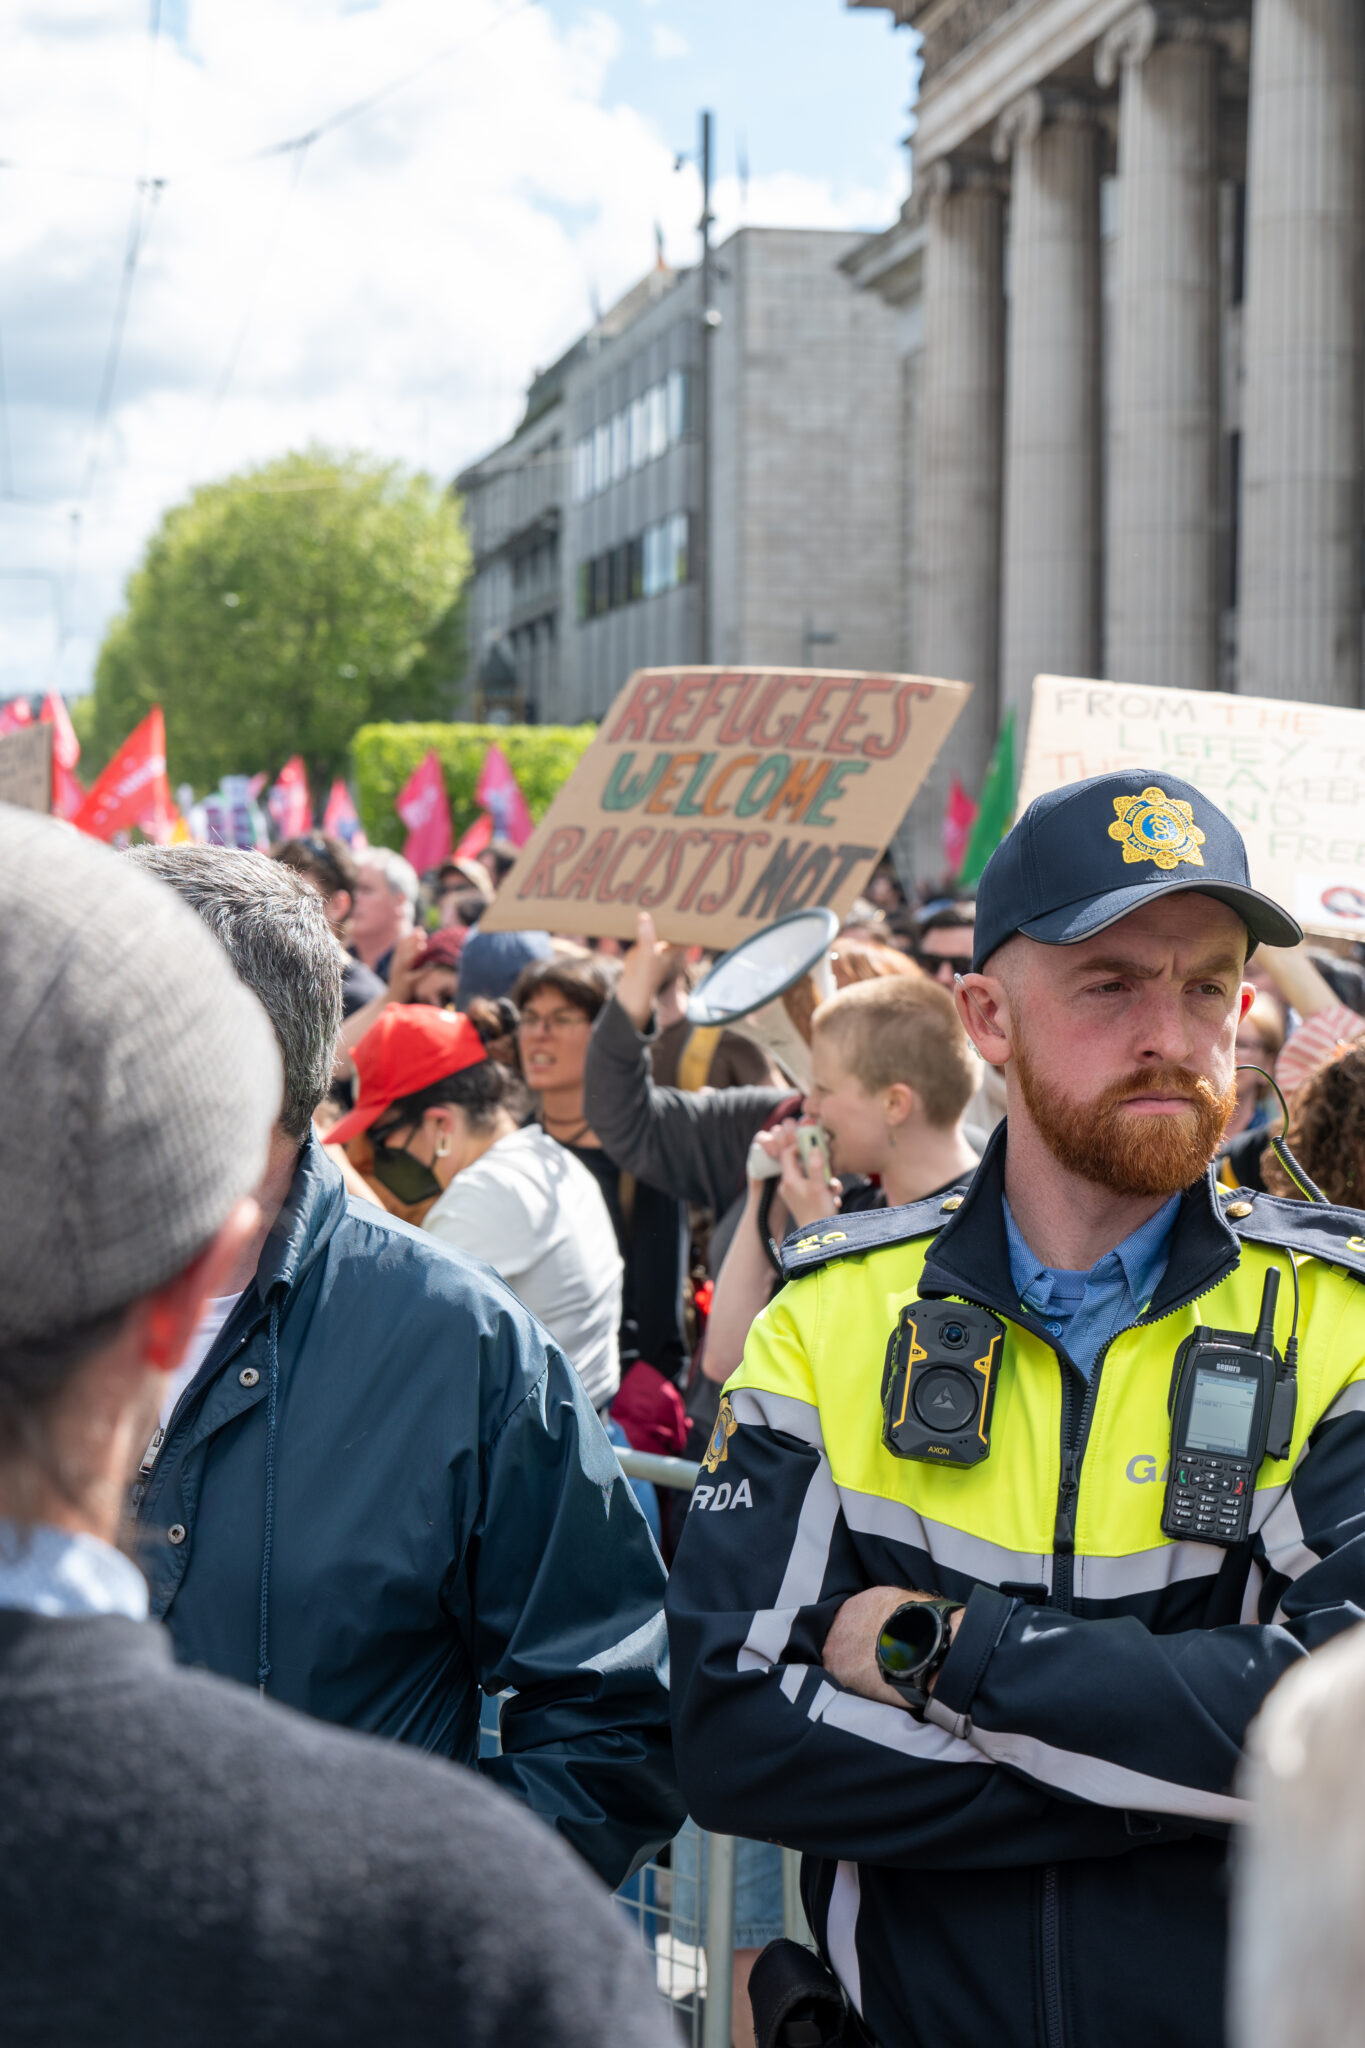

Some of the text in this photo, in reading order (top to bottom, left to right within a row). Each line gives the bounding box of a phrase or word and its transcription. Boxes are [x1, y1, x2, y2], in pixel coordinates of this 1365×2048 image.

[608, 674, 934, 759] REFUGEES
[1055, 688, 1326, 736] FROM THE
[601, 752, 870, 827] WELCOME
[1160, 760, 1268, 793] SEA
[519, 827, 878, 920] RACISTS NOT
[927, 1445, 950, 1456] AXON
